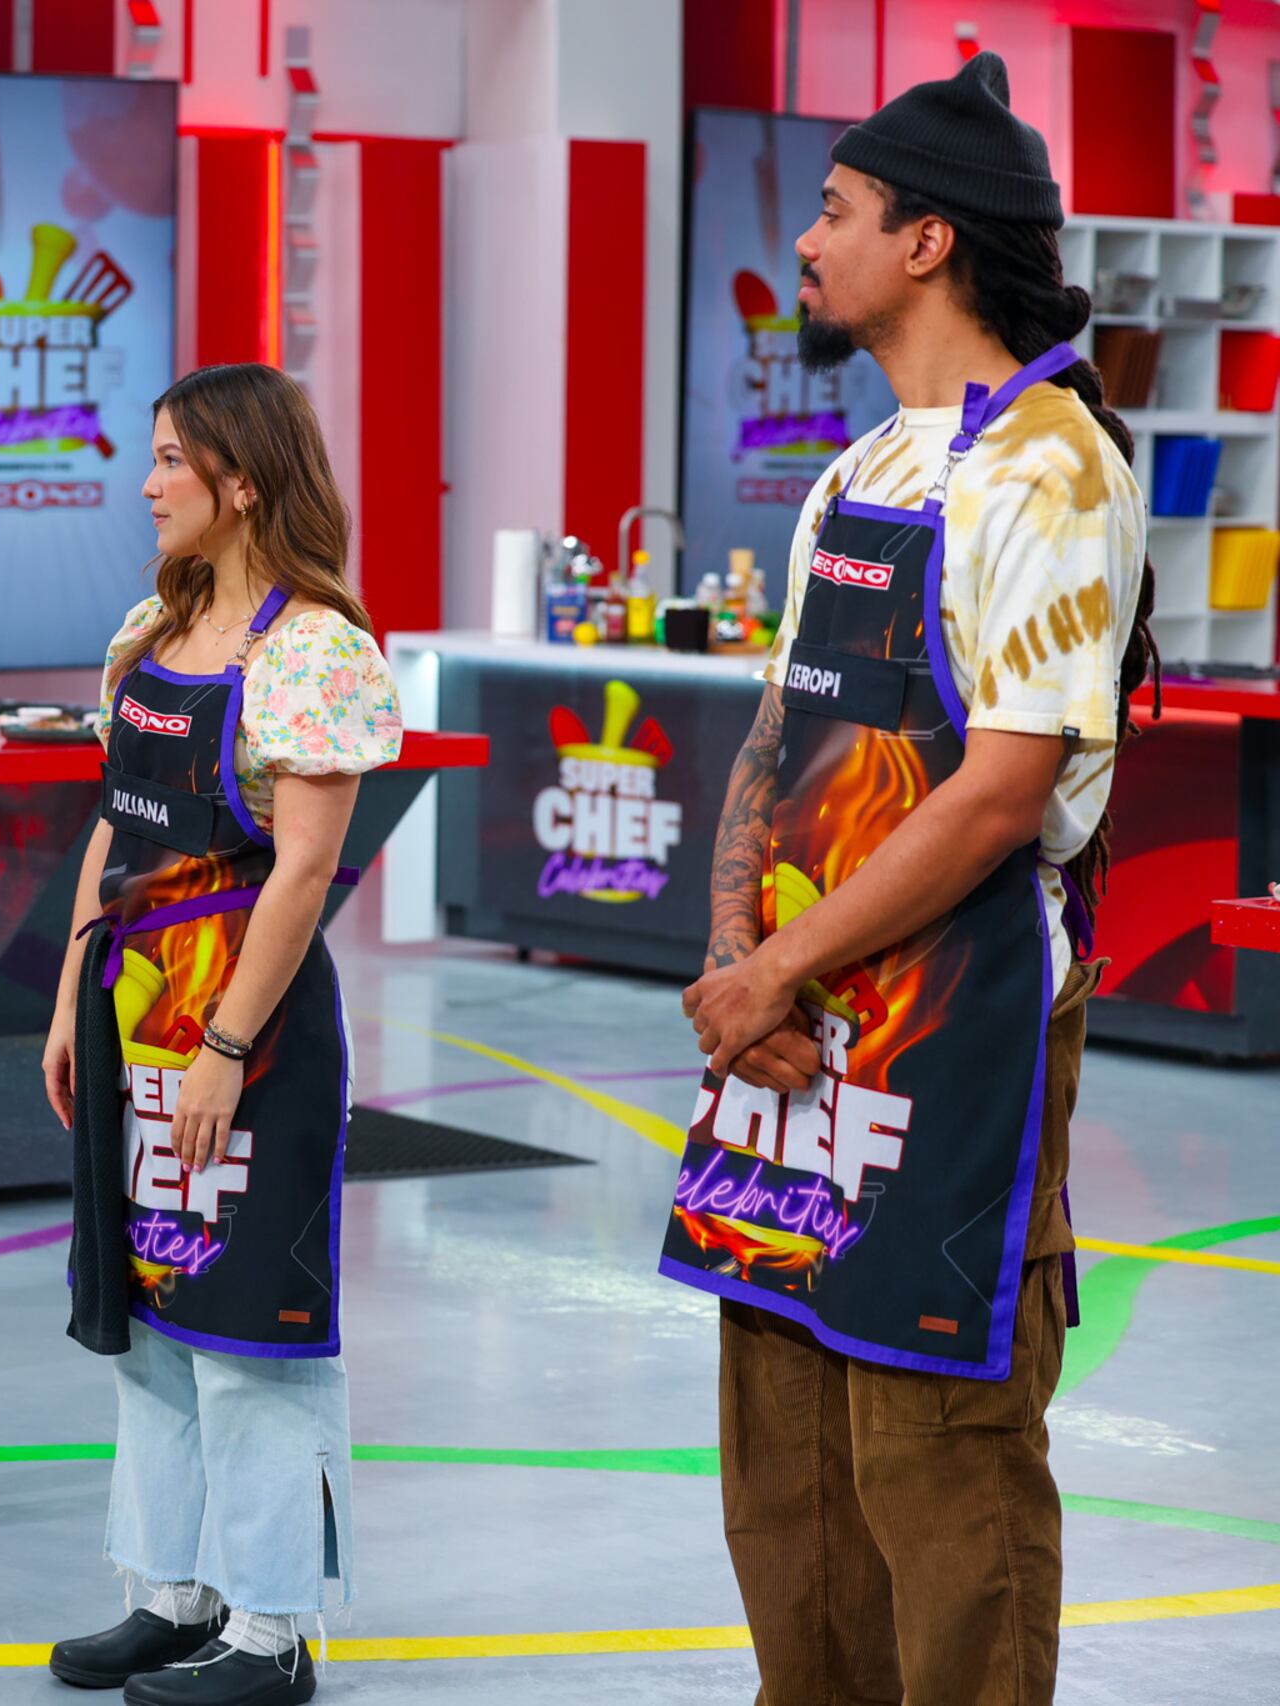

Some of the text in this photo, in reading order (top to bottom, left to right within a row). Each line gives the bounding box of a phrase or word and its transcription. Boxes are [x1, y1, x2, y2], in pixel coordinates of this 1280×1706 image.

[786, 662, 842, 698] KEROPI
[559, 757, 656, 798] SUPER
[112, 788, 169, 827] JULIANA
[533, 785, 683, 866] CHEF
[675, 1150, 858, 1258] elebrities
